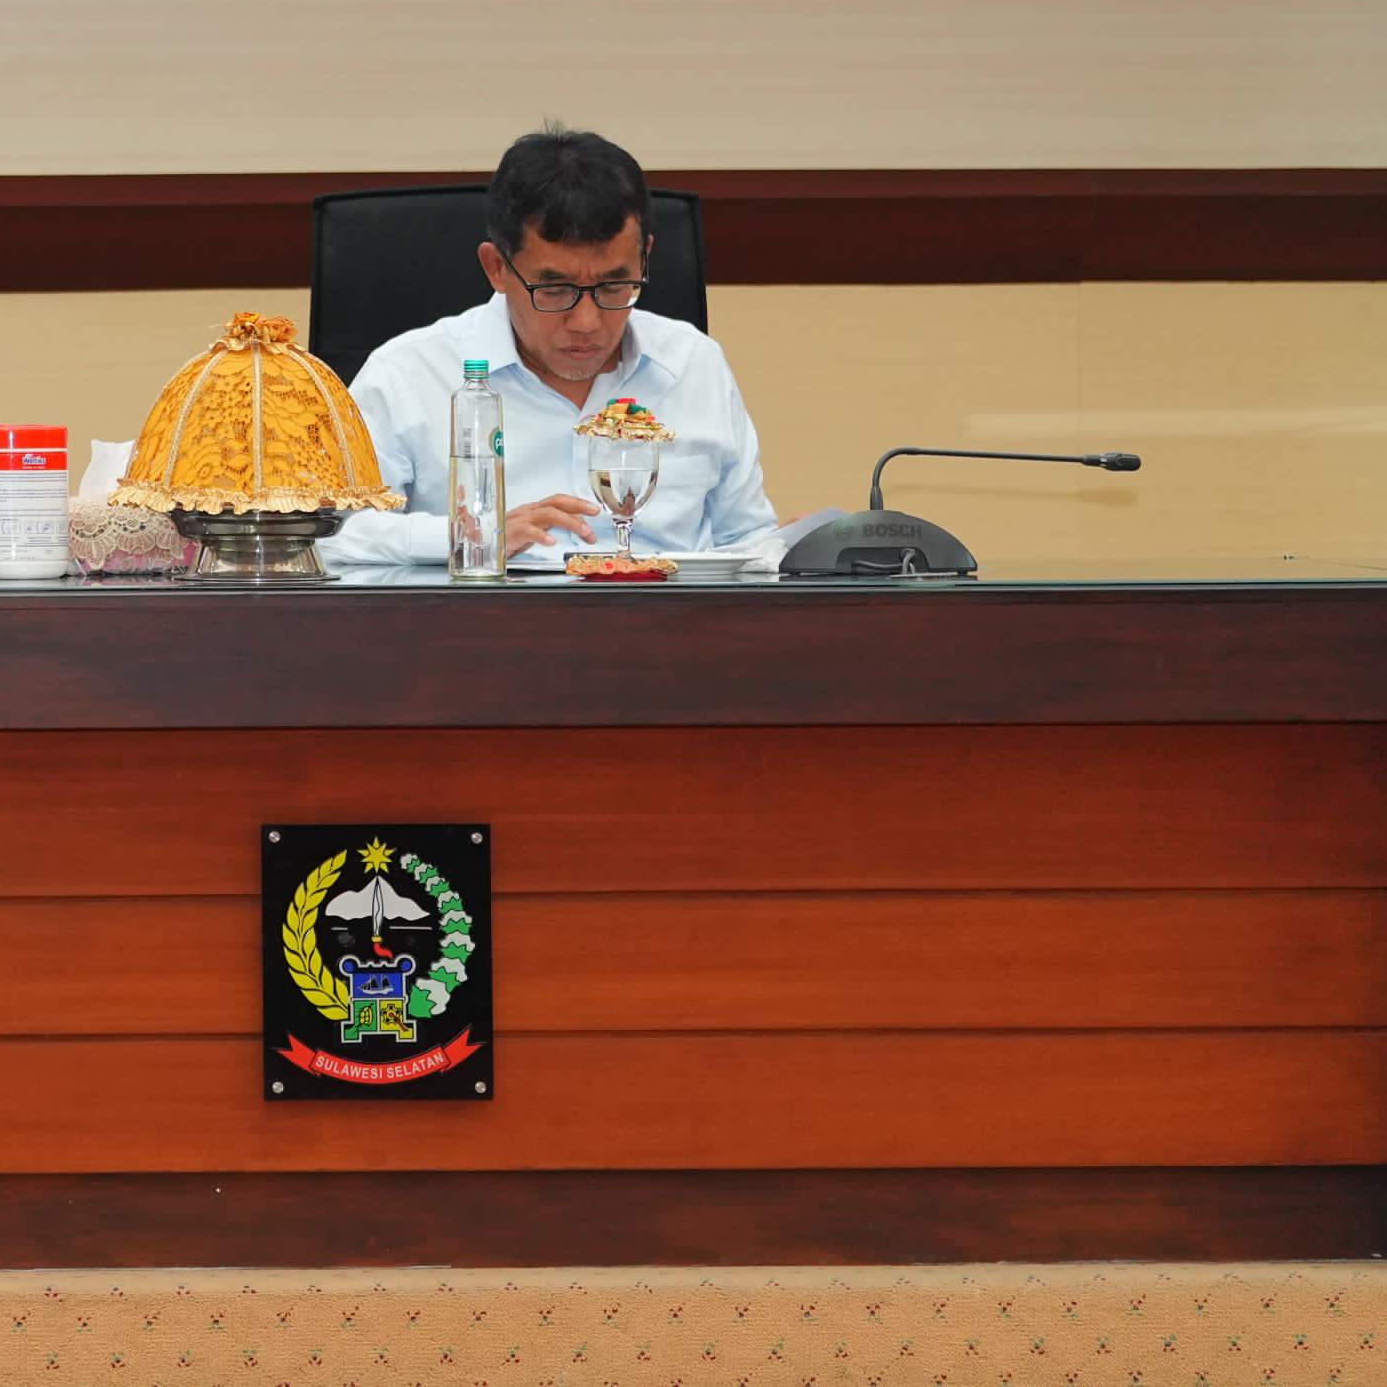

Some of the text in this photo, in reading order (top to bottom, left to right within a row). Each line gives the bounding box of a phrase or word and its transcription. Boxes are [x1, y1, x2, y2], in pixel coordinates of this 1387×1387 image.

[862, 524, 923, 538] BOSCH
[315, 1052, 445, 1080] SULAWESI SELATAN
